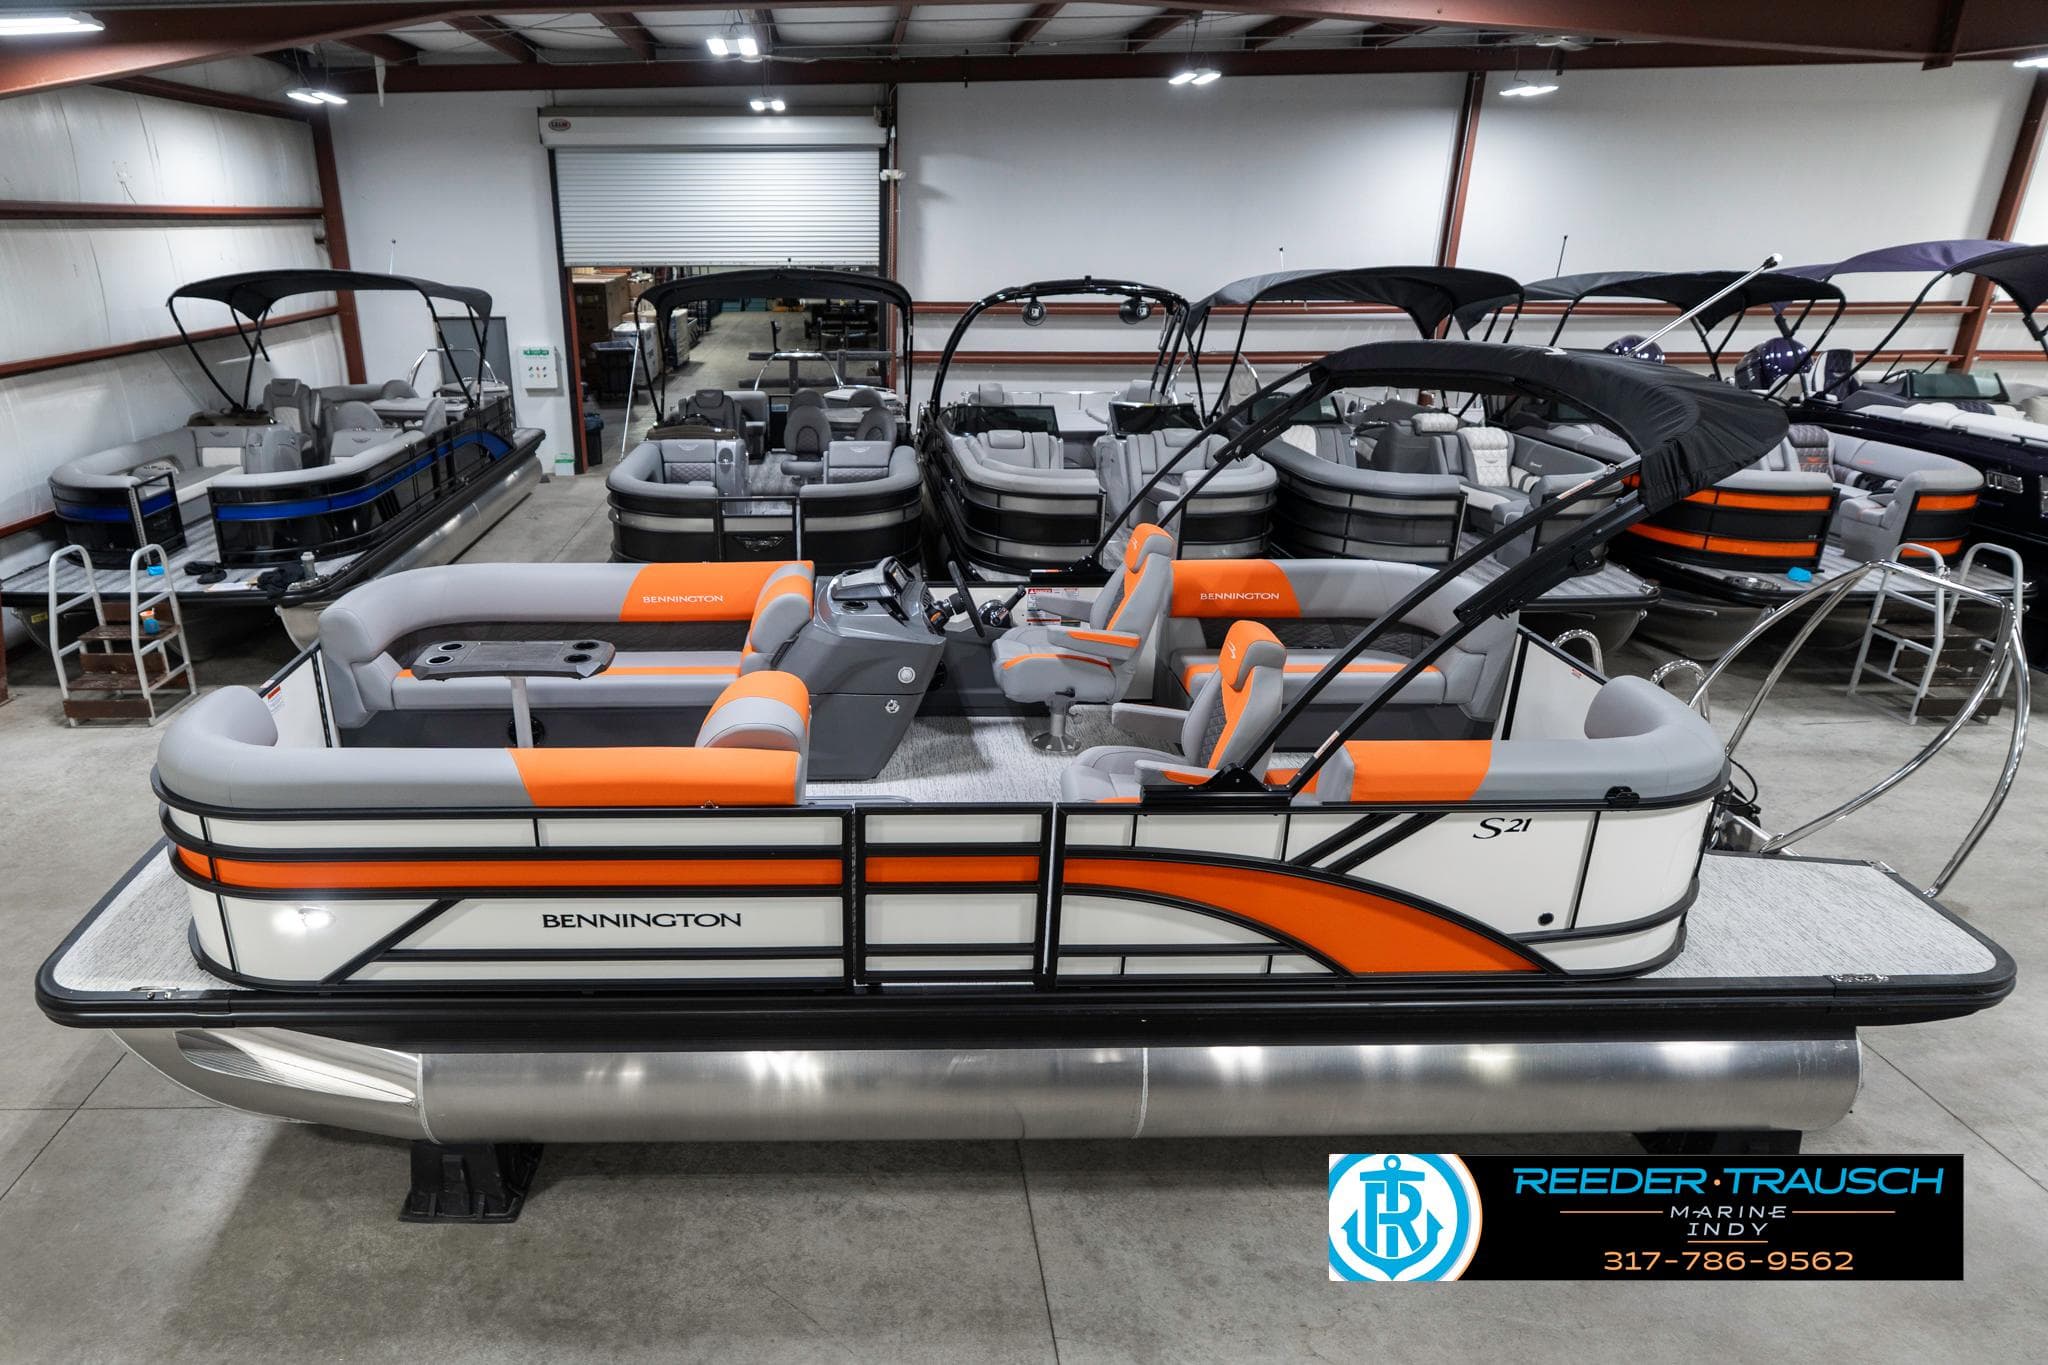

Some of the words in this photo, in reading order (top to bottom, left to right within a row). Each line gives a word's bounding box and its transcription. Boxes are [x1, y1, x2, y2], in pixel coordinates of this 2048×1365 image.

[642, 595, 724, 604] BENNINGTON
[1200, 592, 1280, 600] BENNINGTON
[542, 913, 742, 929] BENNINGTON
